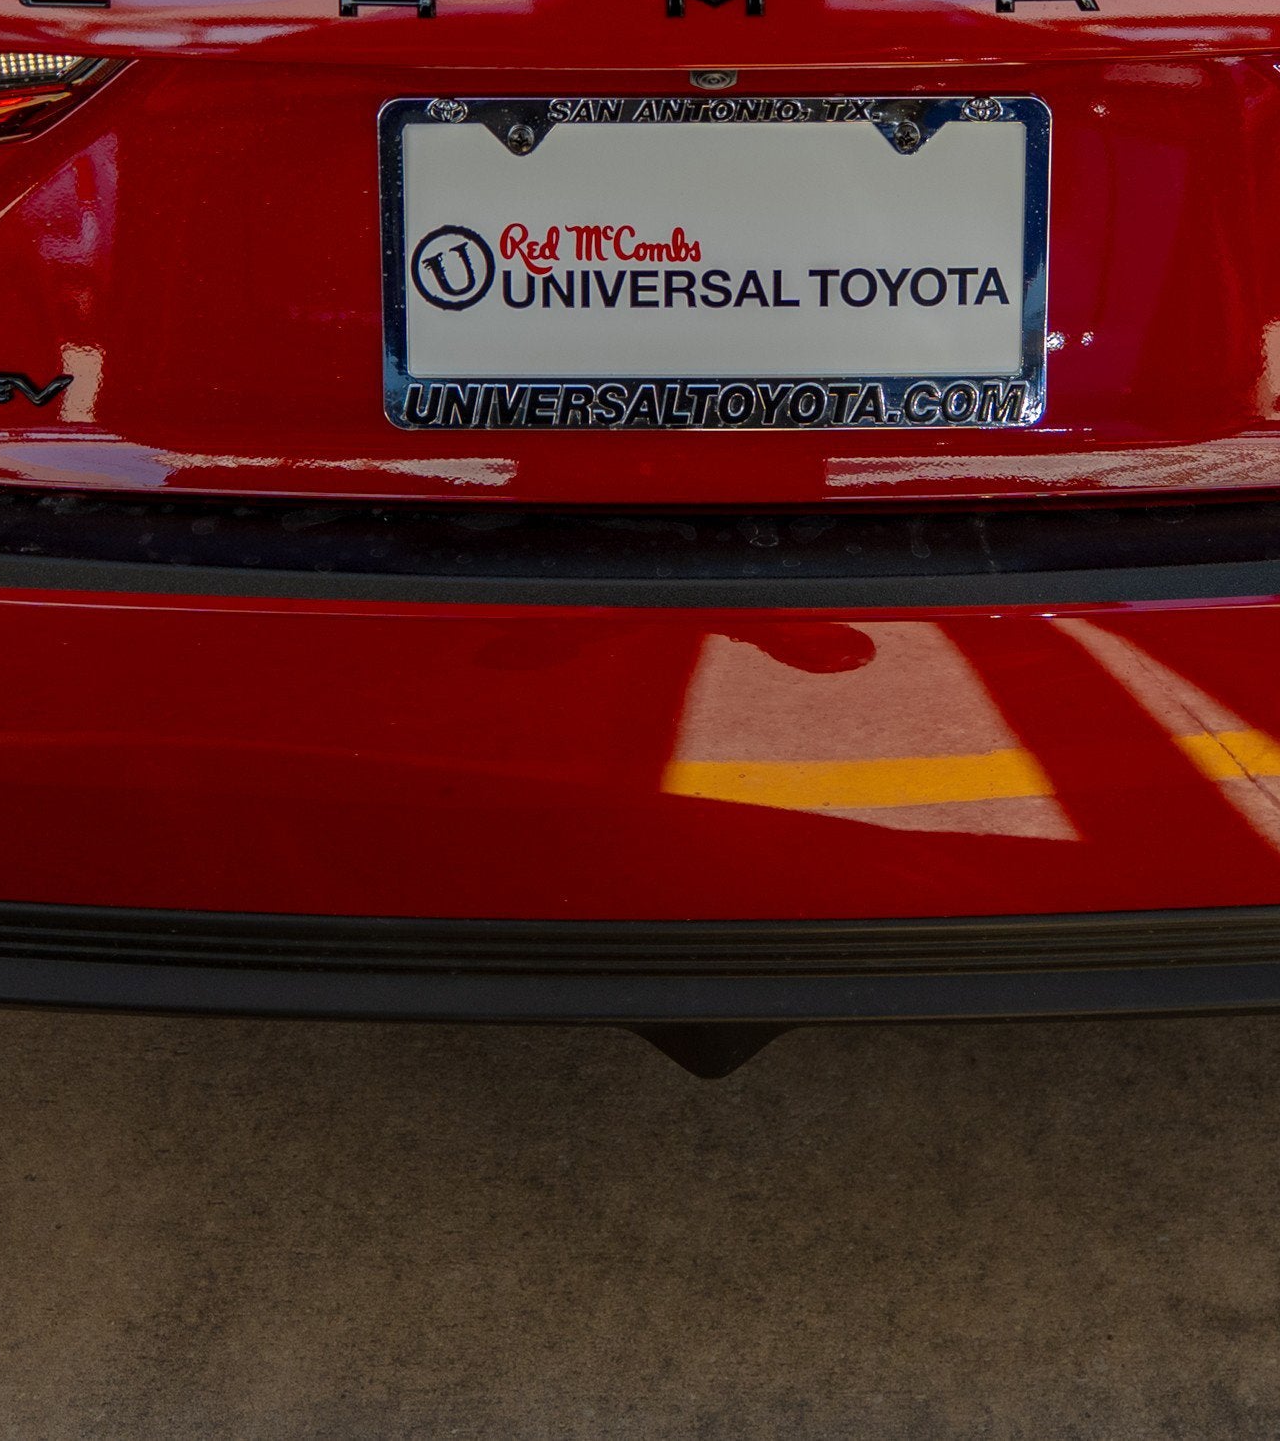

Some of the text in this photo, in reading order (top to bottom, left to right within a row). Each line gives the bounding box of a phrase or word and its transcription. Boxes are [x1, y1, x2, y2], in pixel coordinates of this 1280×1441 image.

[547, 99, 882, 123] SAN ANTONIO, TX.
[499, 222, 702, 275] Red McCombs
[502, 266, 1010, 309] UNIVERSAL TOYOTA
[402, 380, 1029, 426] UNIVERSALTOYOTA.COM
